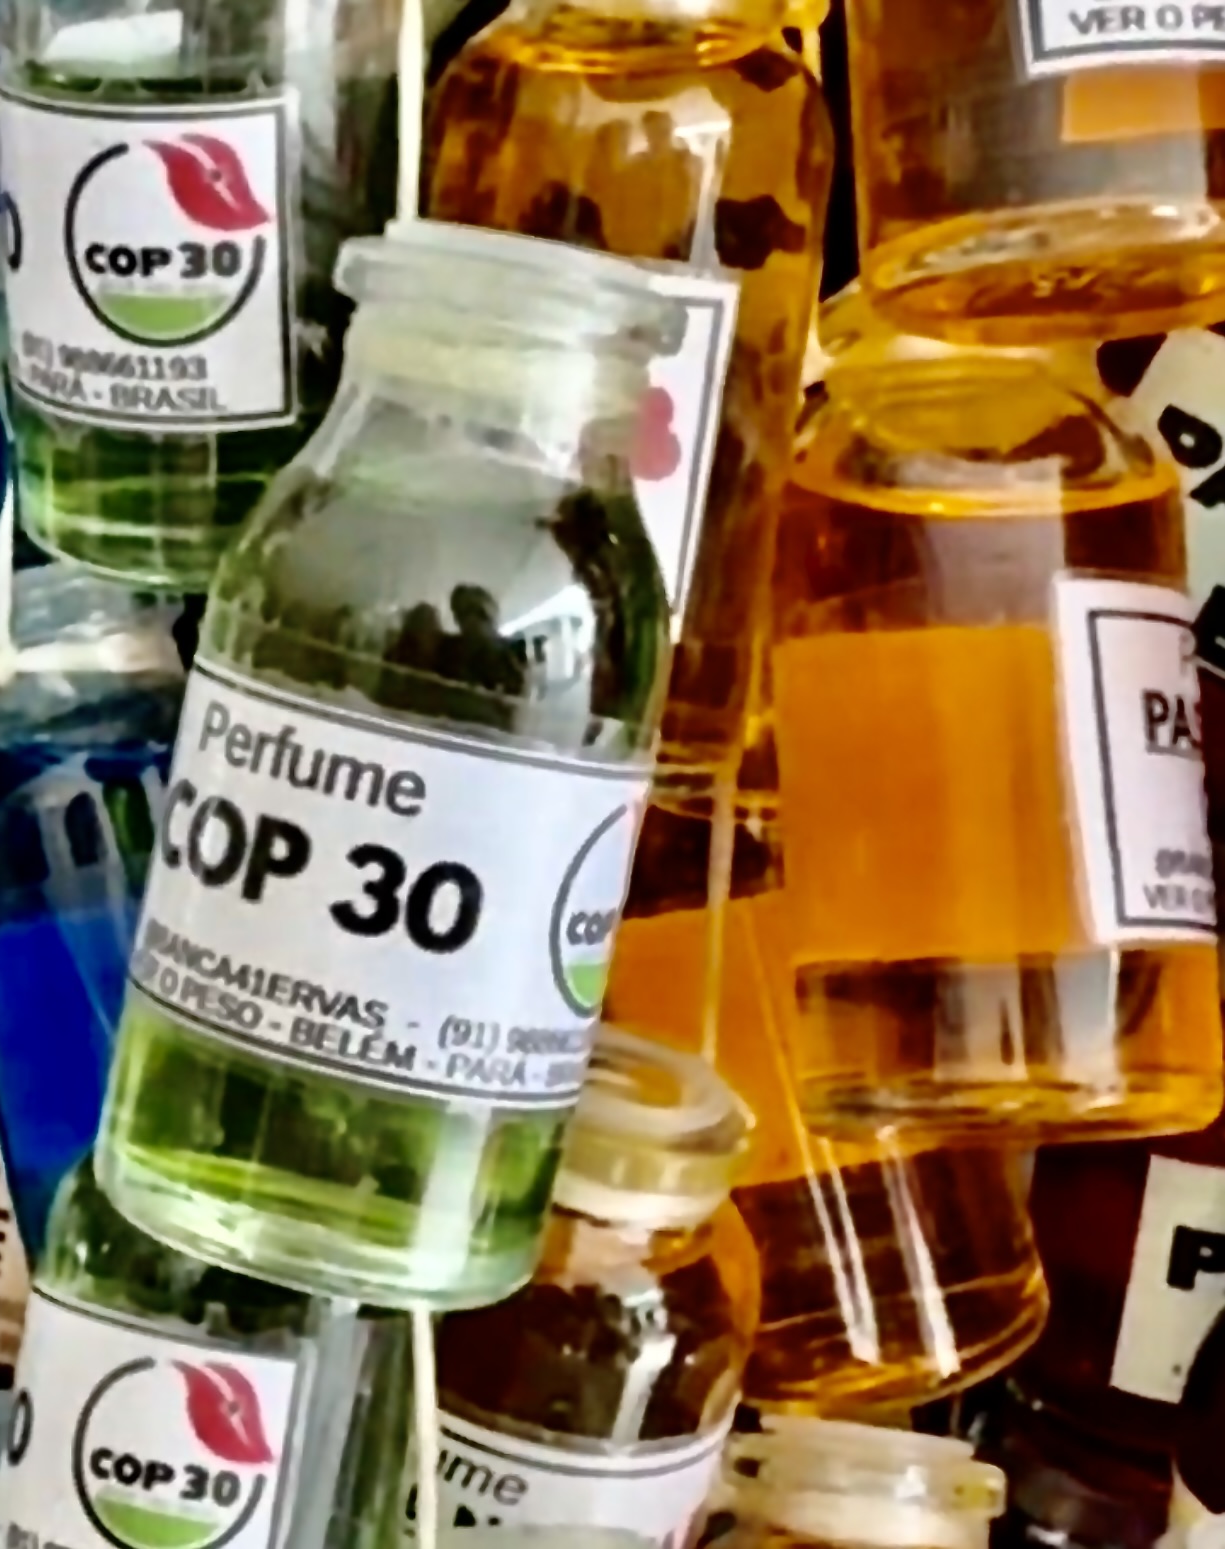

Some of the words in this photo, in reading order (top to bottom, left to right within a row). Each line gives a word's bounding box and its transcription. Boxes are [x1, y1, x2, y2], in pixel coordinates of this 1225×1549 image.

[1068, 6, 1146, 34] VER
[1156, 4, 1183, 30] O
[85, 243, 171, 279] COP
[178, 241, 242, 279] 30
[109, 382, 226, 413] BRASIL
[199, 700, 428, 818] Perfume
[162, 777, 312, 904] COP
[329, 842, 485, 954] 30
[180, 976, 264, 1030] PESO
[438, 1014, 500, 1055] (91)
[89, 1446, 175, 1491] COP
[179, 1464, 241, 1508] 30
